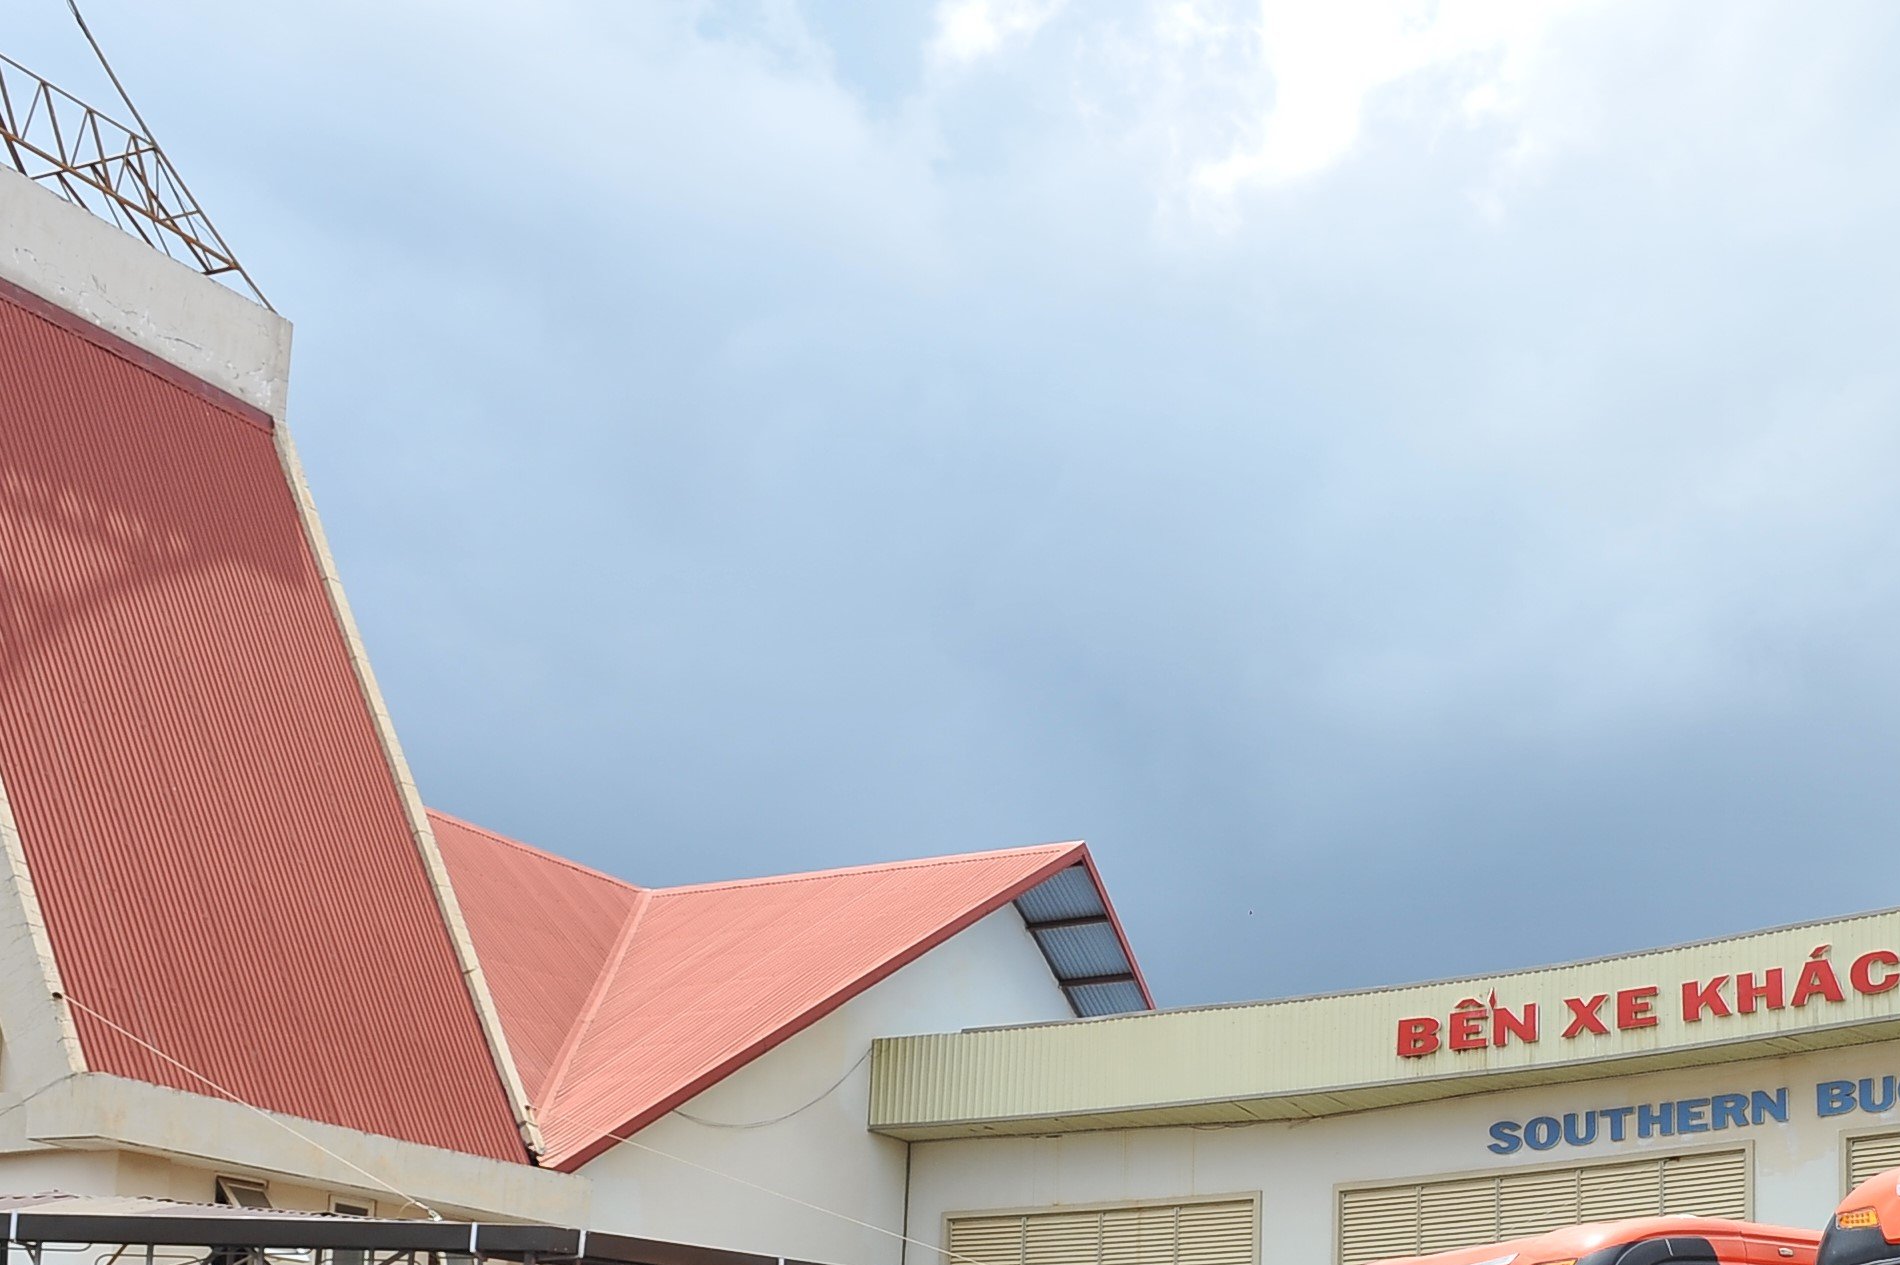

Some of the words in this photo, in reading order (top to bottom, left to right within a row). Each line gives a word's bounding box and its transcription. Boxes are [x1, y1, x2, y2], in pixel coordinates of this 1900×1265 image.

[1397, 987, 1539, 1058] BẾN
[1562, 986, 1658, 1038] XE
[1488, 1087, 1790, 1154] SOUTHERN
